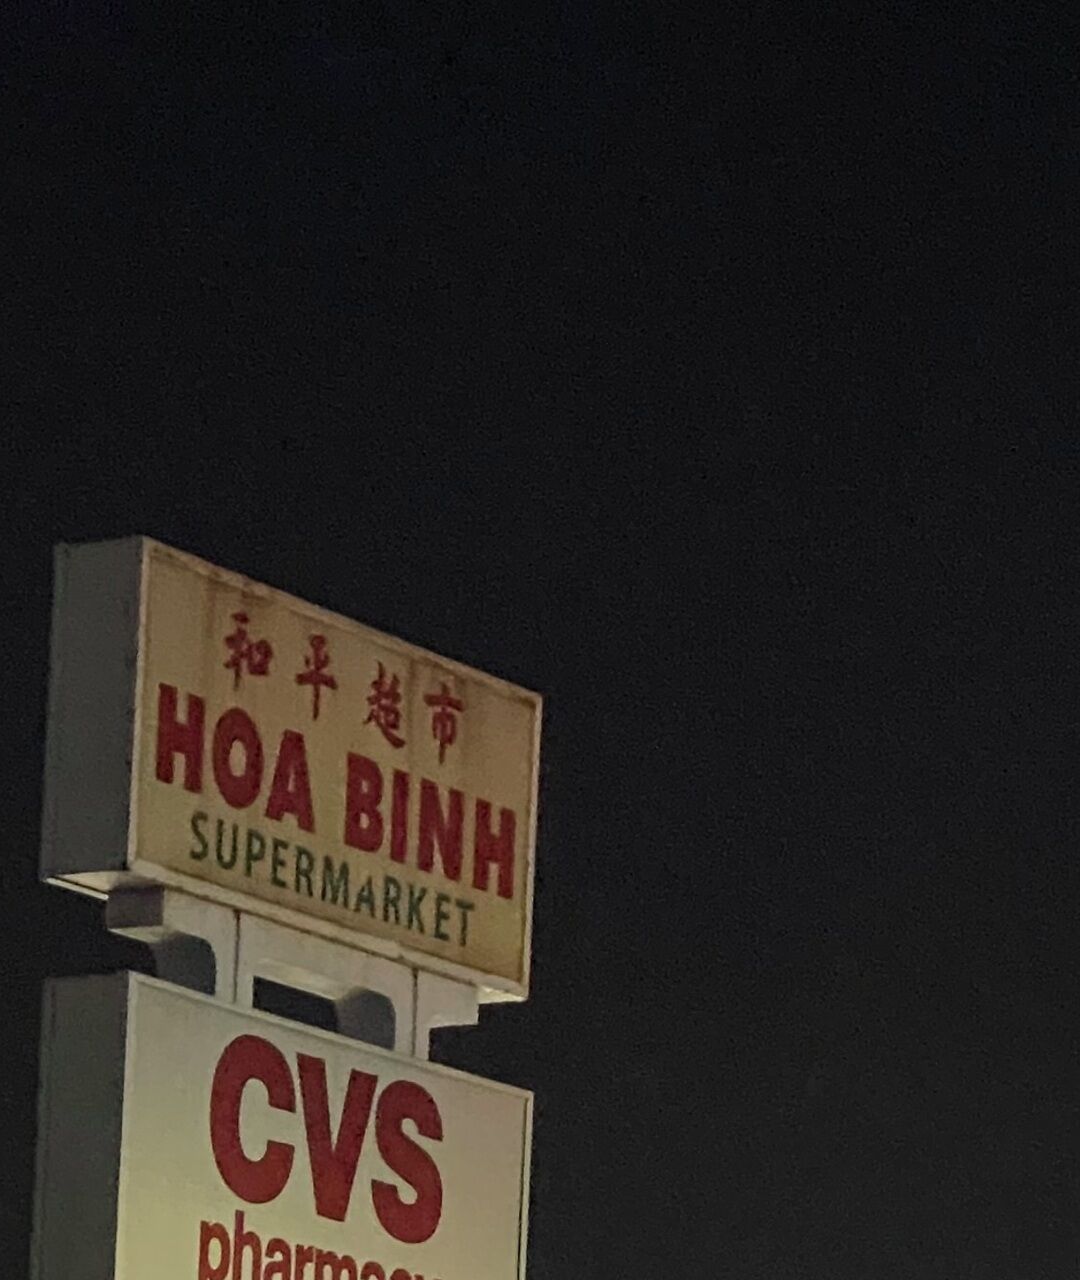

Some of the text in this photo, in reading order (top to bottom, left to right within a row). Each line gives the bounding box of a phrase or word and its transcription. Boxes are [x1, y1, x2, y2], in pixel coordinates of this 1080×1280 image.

[224, 612, 465, 764] 和平超市
[156, 683, 517, 899] HOA BINH
[190, 811, 475, 947] SUPERMARKET
[210, 1034, 443, 1244] CVS
